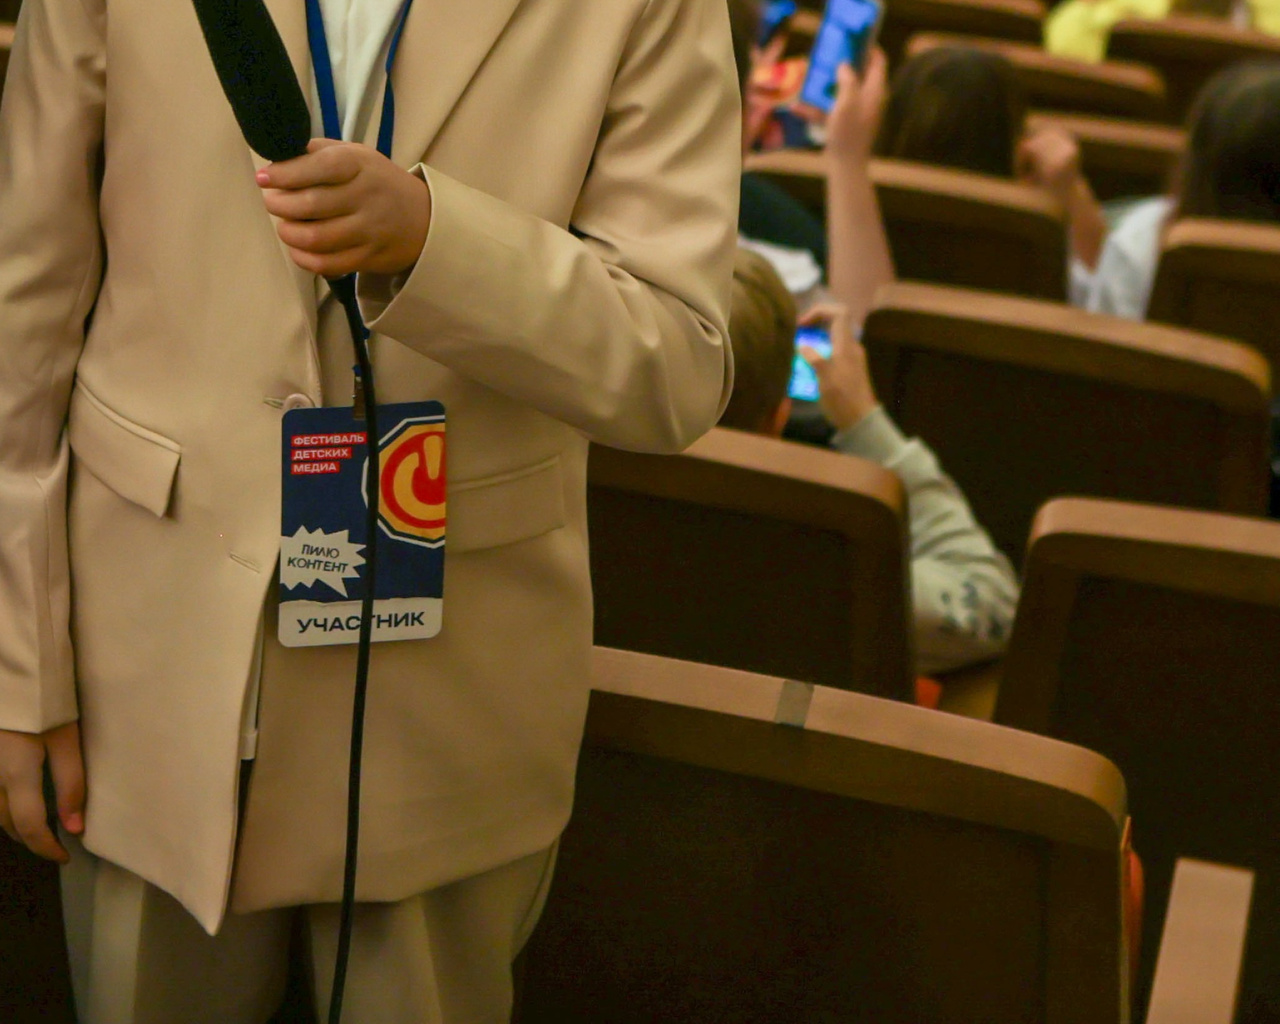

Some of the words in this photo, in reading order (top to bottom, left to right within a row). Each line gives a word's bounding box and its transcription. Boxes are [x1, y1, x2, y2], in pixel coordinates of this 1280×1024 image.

[294, 434, 364, 445] ФЕСТИВАЛЬ
[293, 449, 348, 460] ДЕТСКИХ
[294, 463, 337, 473] МЕДИА
[301, 544, 340, 558] ПИЛЮ
[287, 558, 349, 573] КОНТЕНТ
[297, 611, 425, 633] УЧАСНИК
